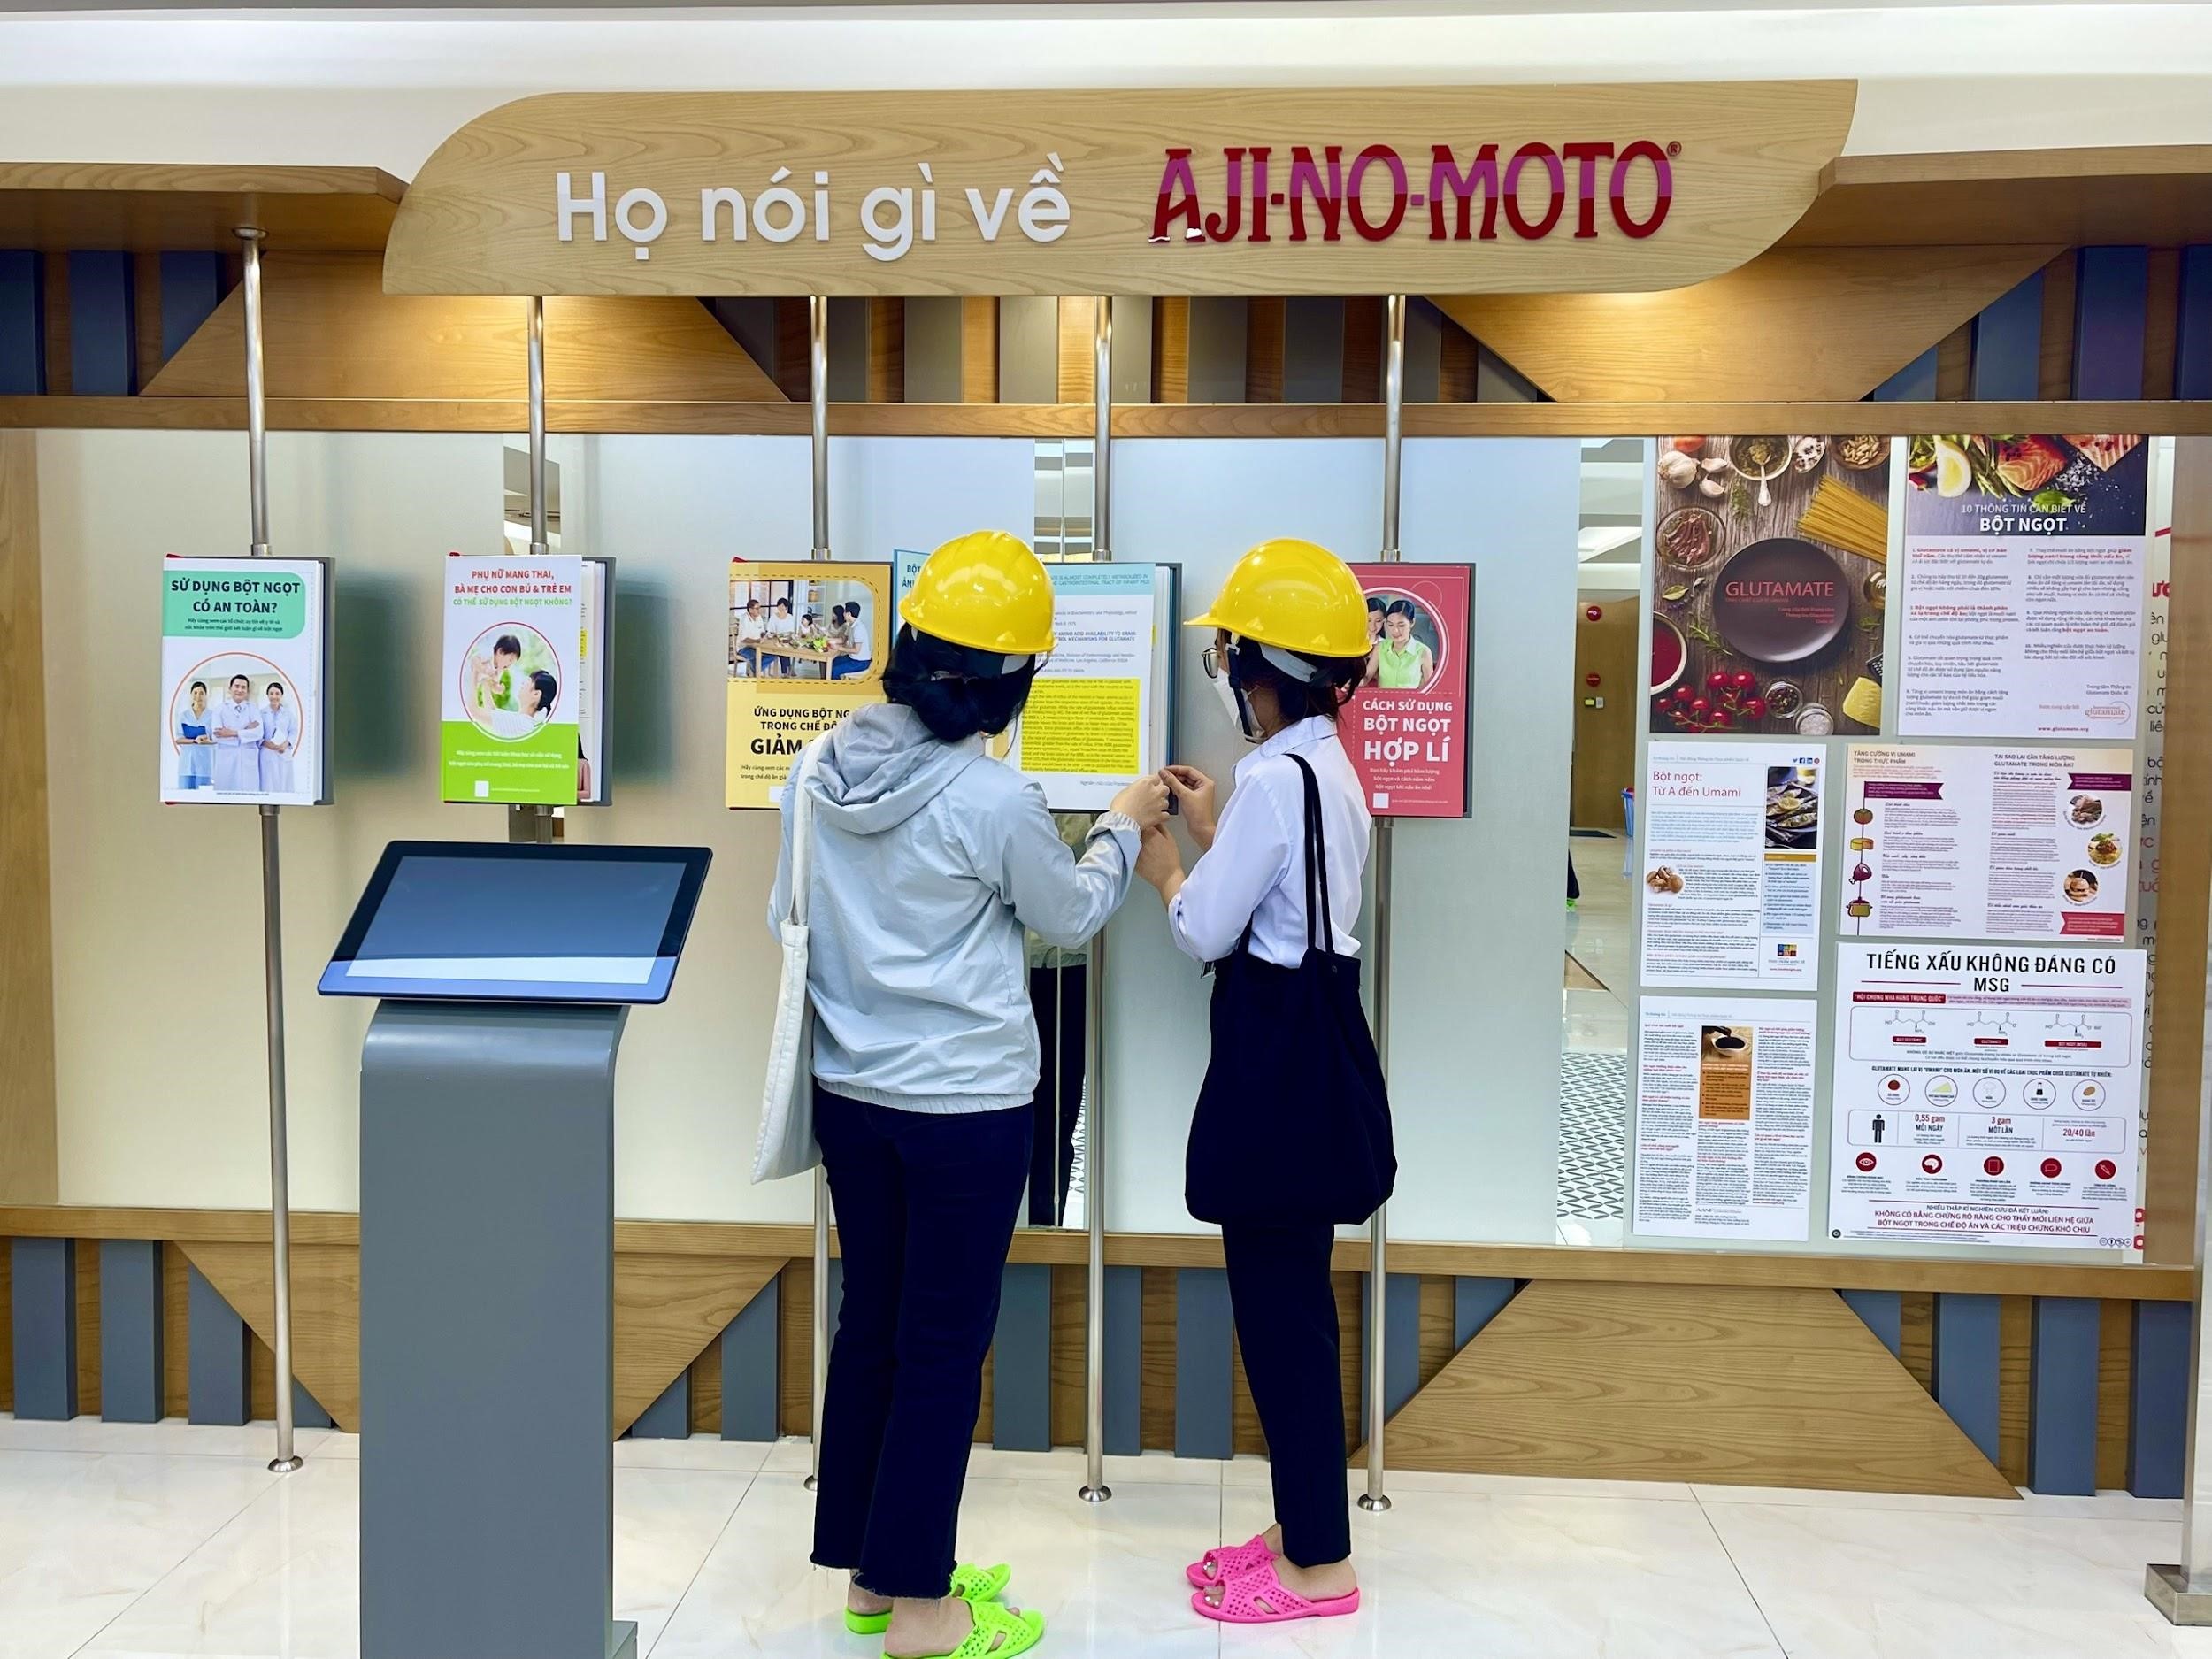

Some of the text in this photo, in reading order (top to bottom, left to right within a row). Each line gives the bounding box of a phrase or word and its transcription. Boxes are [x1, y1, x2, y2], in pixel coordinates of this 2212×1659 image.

[557, 152, 1071, 262] Họ nói gì về
[1962, 504, 1973, 513] 10
[1975, 503, 2008, 513] THÔNG
[1979, 514, 2067, 535] BỘT NGỌT
[472, 570, 489, 581] PHỤ
[505, 570, 530, 579] MANG
[531, 570, 555, 580] THAI,
[171, 577, 301, 596] SỬ DỤNG BỘT NGỌT
[455, 583, 465, 594] BÀ
[466, 585, 479, 596] MẸ
[480, 585, 498, 594] CHO
[500, 585, 518, 594] CON
[519, 583, 531, 594] BÚ
[559, 585, 572, 594] EM
[1725, 581, 1834, 596] GLUTAMATE
[193, 598, 278, 613] CÓ AN TOÀN?
[754, 705, 777, 717] ỨNG
[780, 708, 810, 719] DỤNG
[811, 707, 833, 720] BỘT
[1363, 697, 1453, 714] CÁCH SỬ DỤNG
[761, 721, 797, 731] TRONG
[800, 719, 821, 731] CHẾ
[1363, 714, 1451, 736] BỘT NGỌT
[750, 733, 803, 756] GIẢM
[1364, 735, 1451, 767] HỢP LÍ
[1653, 771, 1703, 784] Bột ngọt:
[1652, 786, 1741, 797] Từ A đến Umami
[1866, 949, 2116, 974] TIẾNG XẤU KHÔNG ĐÁNG CÓ
[1974, 978, 2009, 992] MSG
[1931, 1115, 1945, 1124] gam
[2063, 1128, 2084, 1137] 20/40
